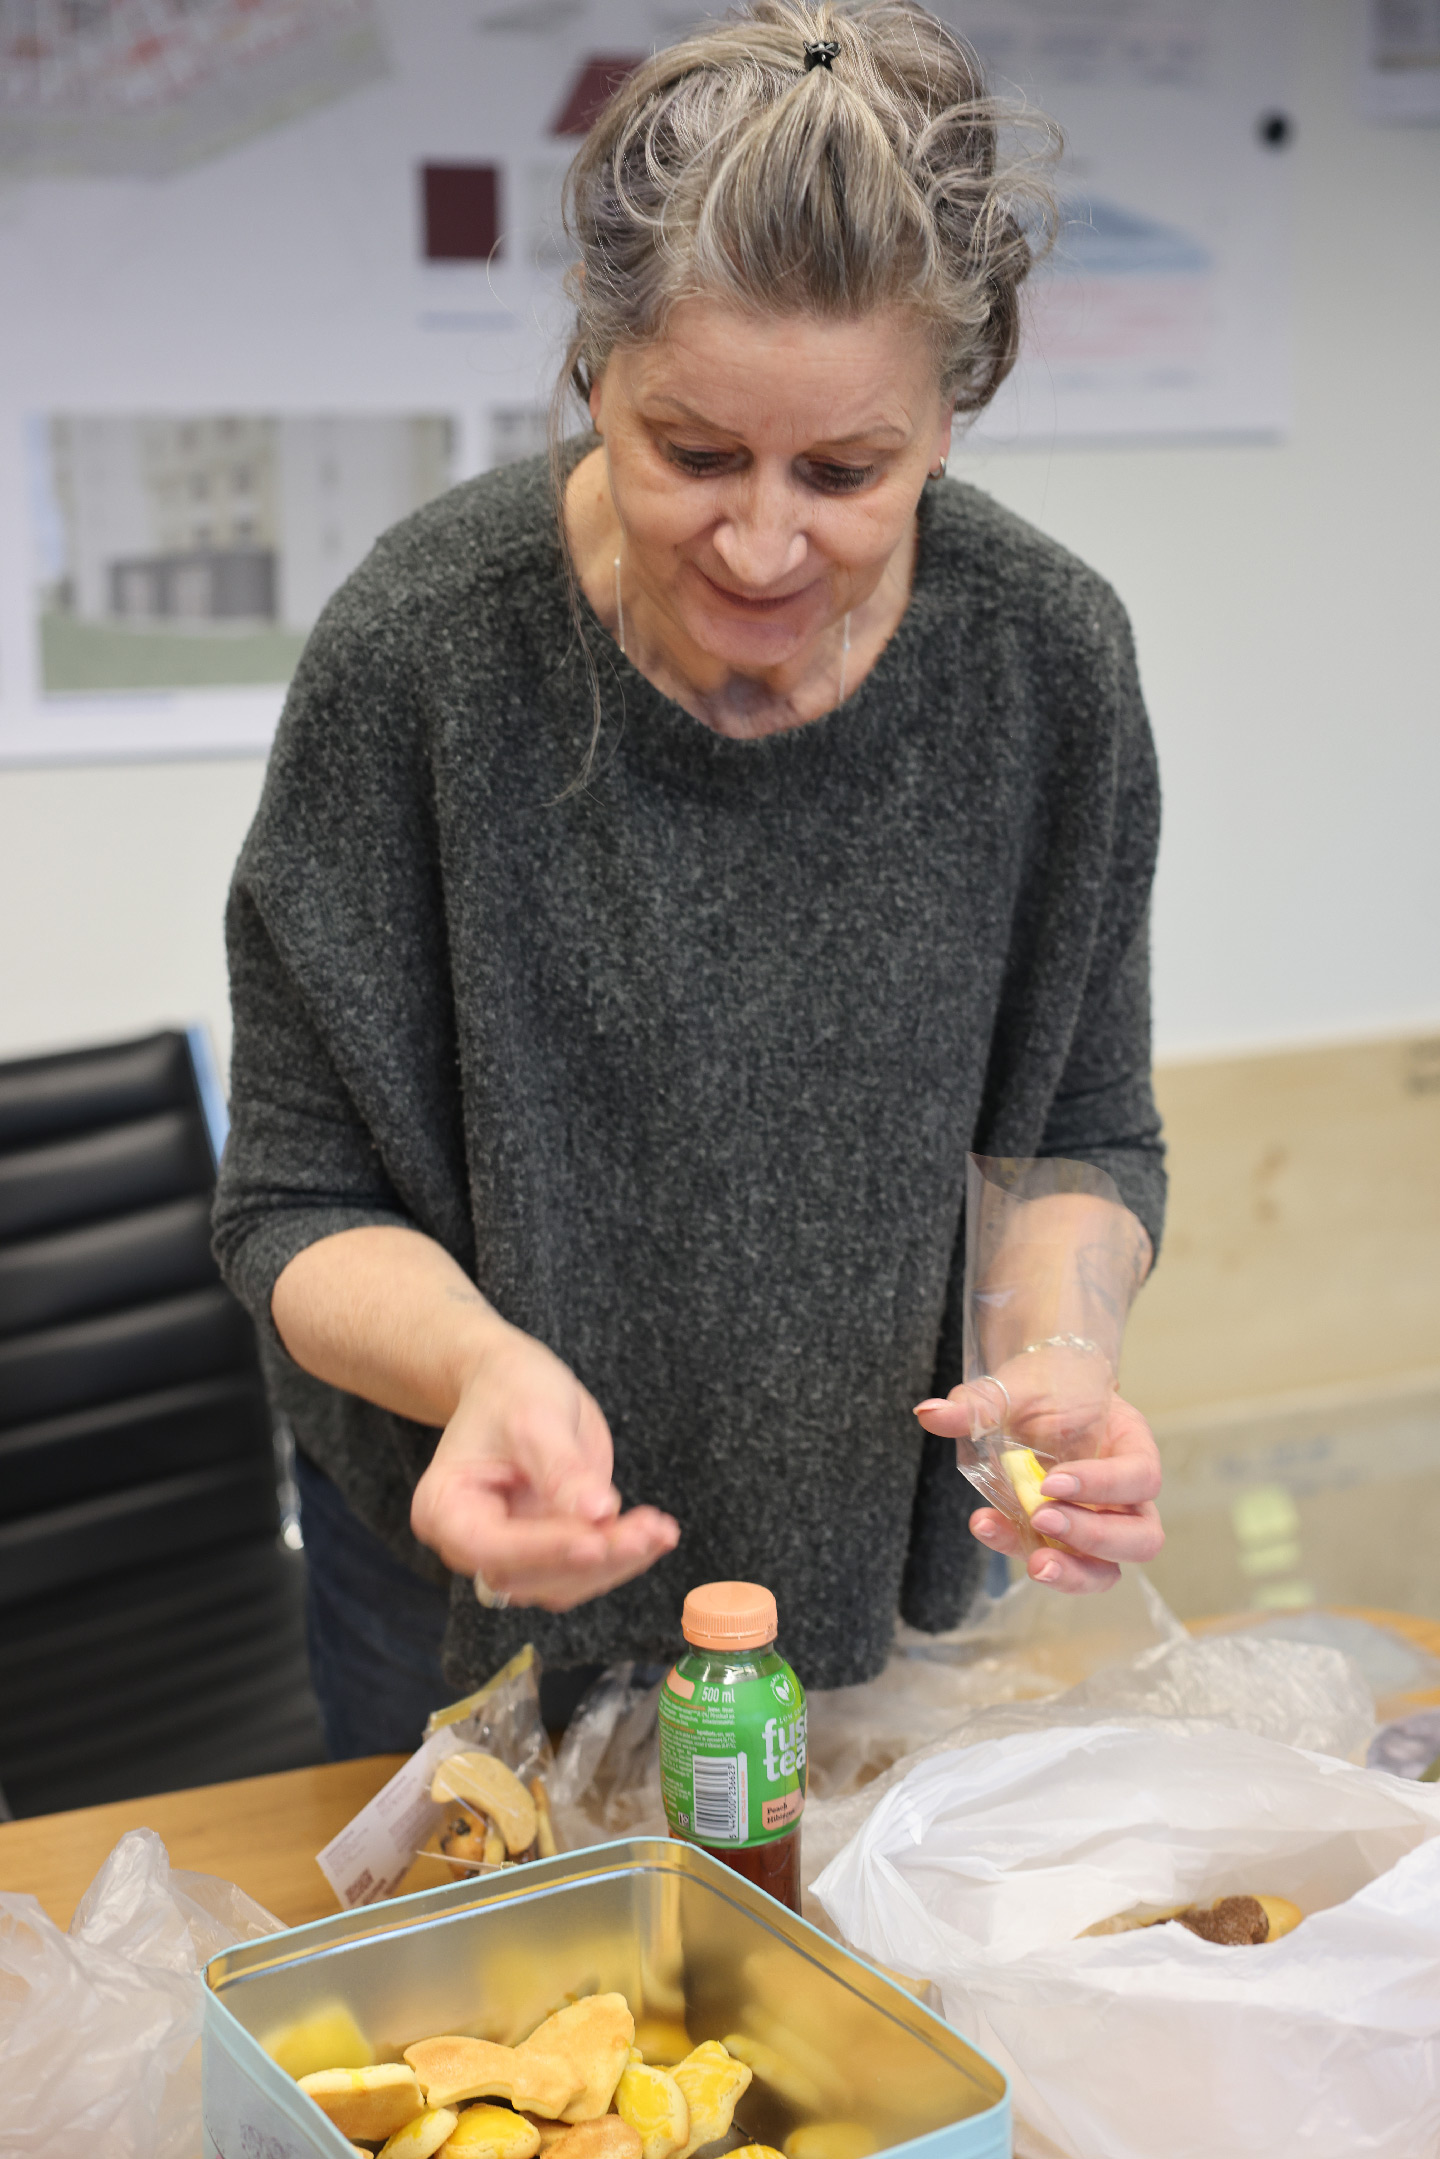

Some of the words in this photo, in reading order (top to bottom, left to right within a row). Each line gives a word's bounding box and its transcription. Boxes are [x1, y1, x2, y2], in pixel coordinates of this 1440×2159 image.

[701, 1686, 720, 1703] 500
[721, 1687, 736, 1704] ml
[763, 1741, 806, 1782] tea
[767, 1802, 788, 1815] Peach
